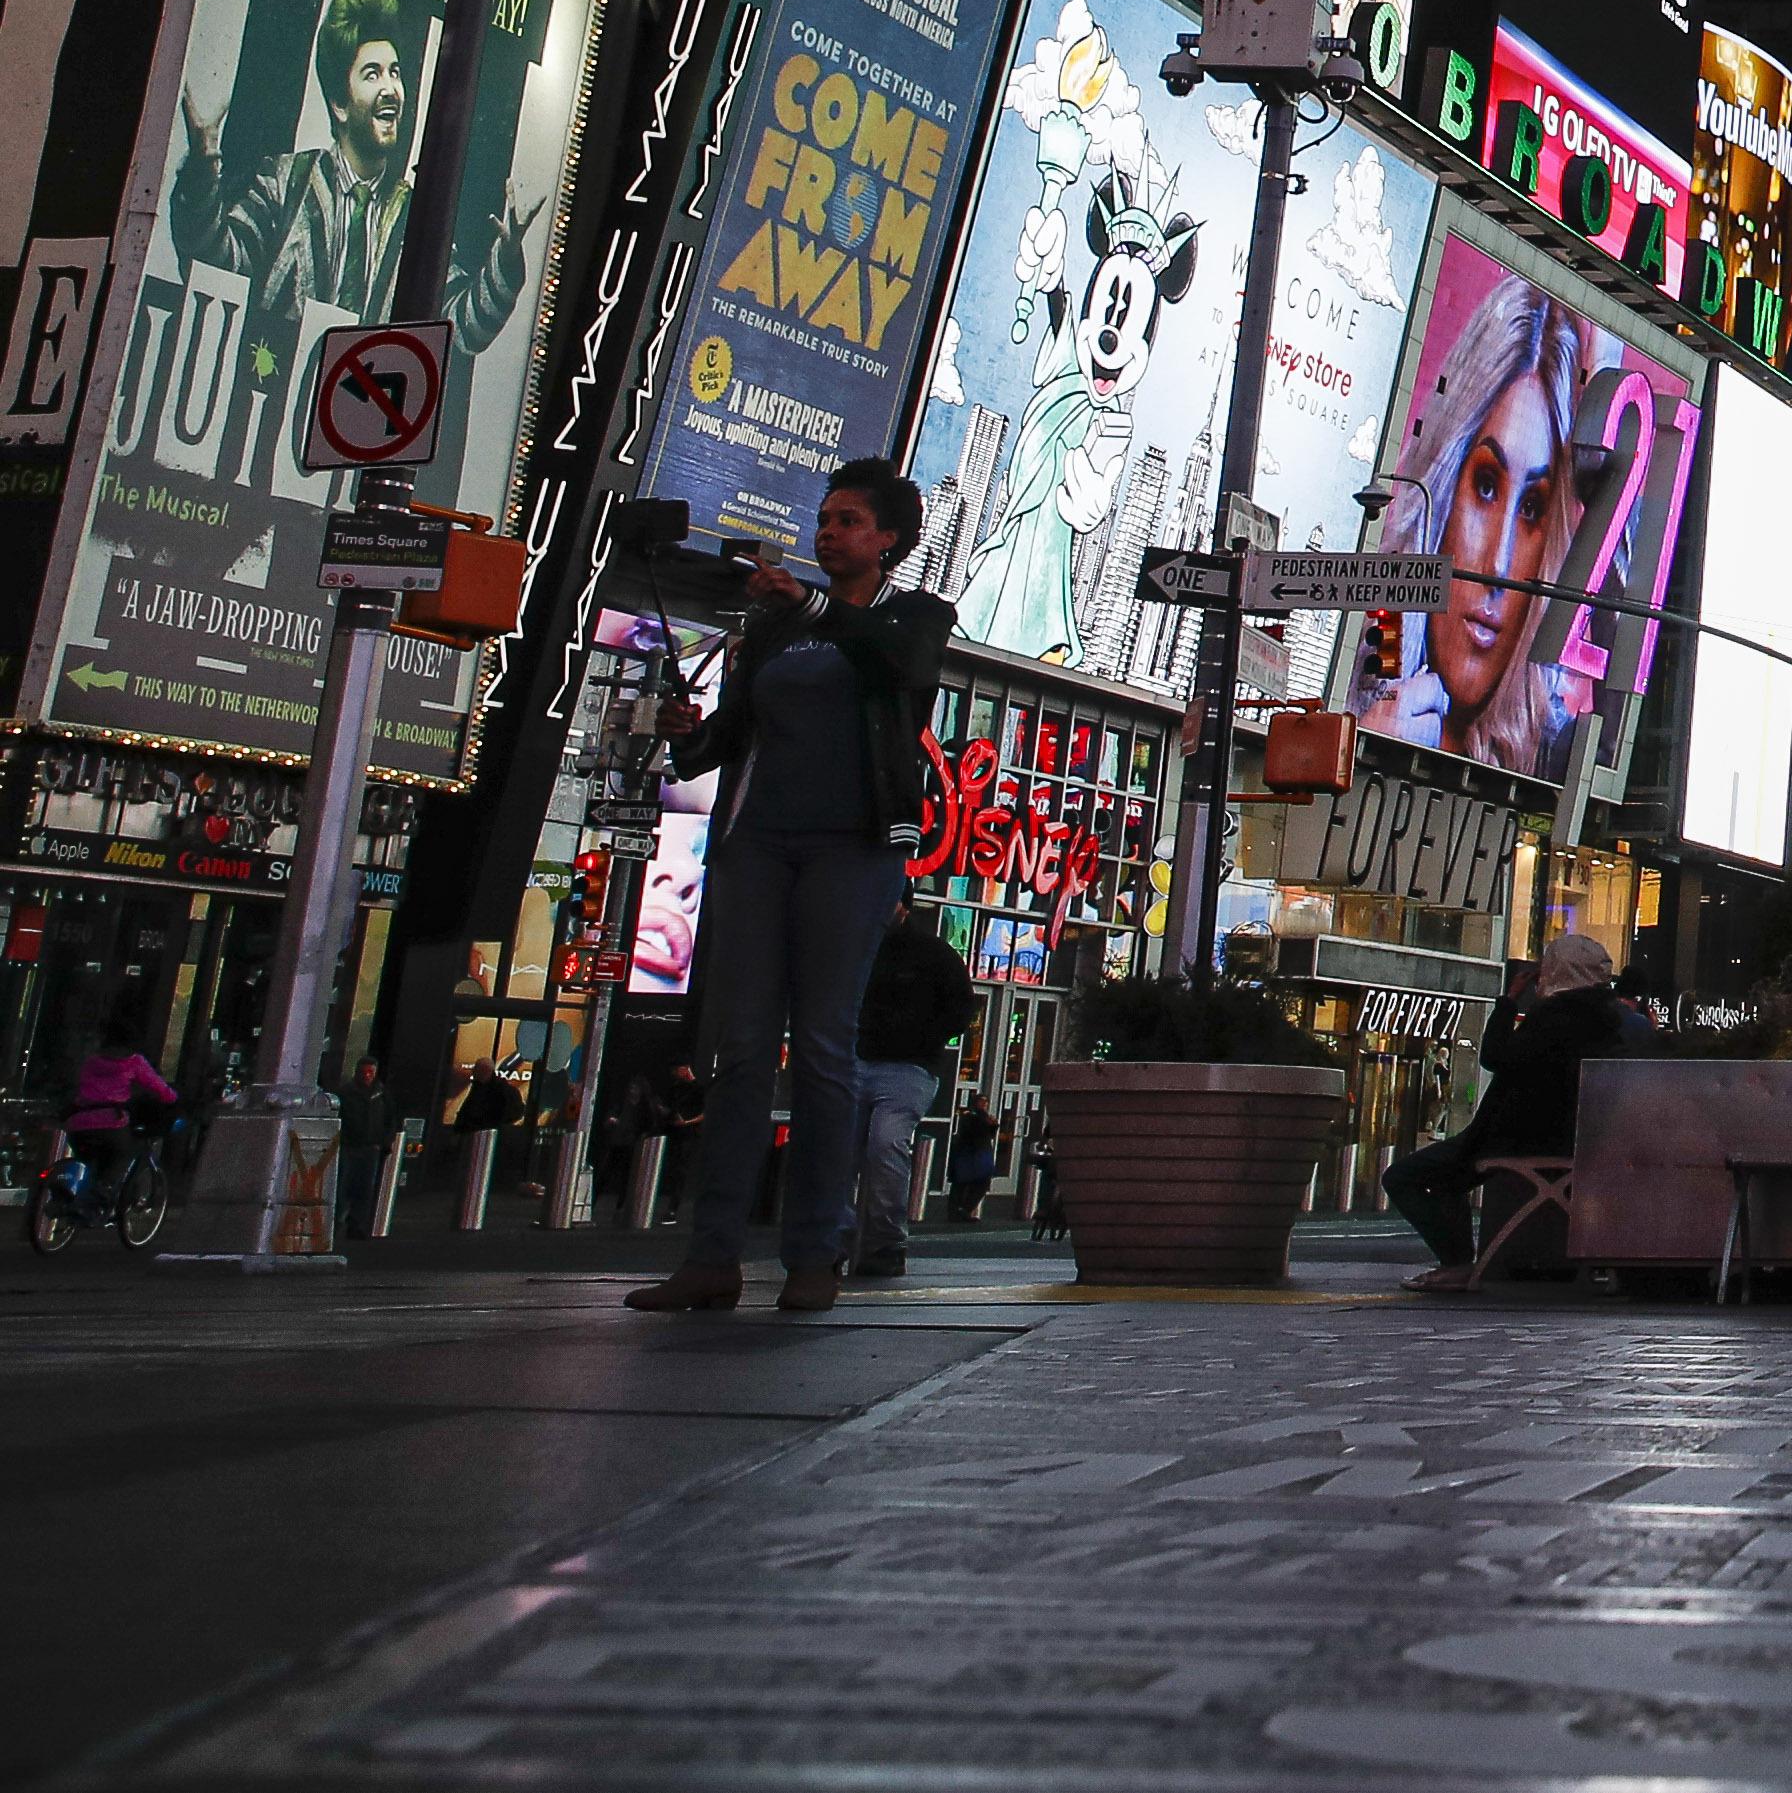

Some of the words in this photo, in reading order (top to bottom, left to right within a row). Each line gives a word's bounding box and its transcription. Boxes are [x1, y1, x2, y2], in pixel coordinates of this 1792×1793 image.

[916, 13, 957, 51] AMERICA
[790, 19, 844, 64] COME
[846, 48, 934, 110] TOGETHER
[935, 97, 958, 126] AT
[772, 52, 950, 200] COME
[1697, 77, 1779, 169] YouTube
[717, 216, 912, 353] AWAY
[711, 296, 735, 319] THE
[738, 305, 819, 352] REMARKABLE
[821, 340, 850, 365] TRUE
[851, 353, 889, 379] STORY
[1303, 354, 1353, 399] store
[742, 384, 845, 450] MASTERPIECE!
[769, 436, 790, 460] and
[786, 442, 822, 474] plenty
[100, 473, 140, 510] The
[145, 486, 231, 529] Musical.
[333, 532, 374, 546] Times
[377, 534, 428, 550] Square
[403, 550, 439, 564] Plaza
[1163, 563, 1207, 592] ONE
[1271, 557, 1360, 579] PEDESTRIAN
[1363, 558, 1403, 580] FLOW
[1404, 560, 1443, 581] ZONE
[1345, 582, 1381, 603] KEEP
[1385, 583, 1441, 605] MOVING
[145, 584, 324, 656] JAW-DROPPING
[134, 676, 164, 701] THIS
[166, 681, 197, 707] WAY
[200, 686, 217, 708] TO
[220, 689, 245, 714] THE
[395, 720, 459, 749] BROADWAY
[47, 838, 90, 861] Apple
[104, 840, 167, 869] Nikon
[1320, 770, 1519, 911] FOREVER
[178, 850, 252, 881] Canon
[1356, 989, 1442, 1038] FOREVER
[1439, 1000, 1465, 1040] 21
